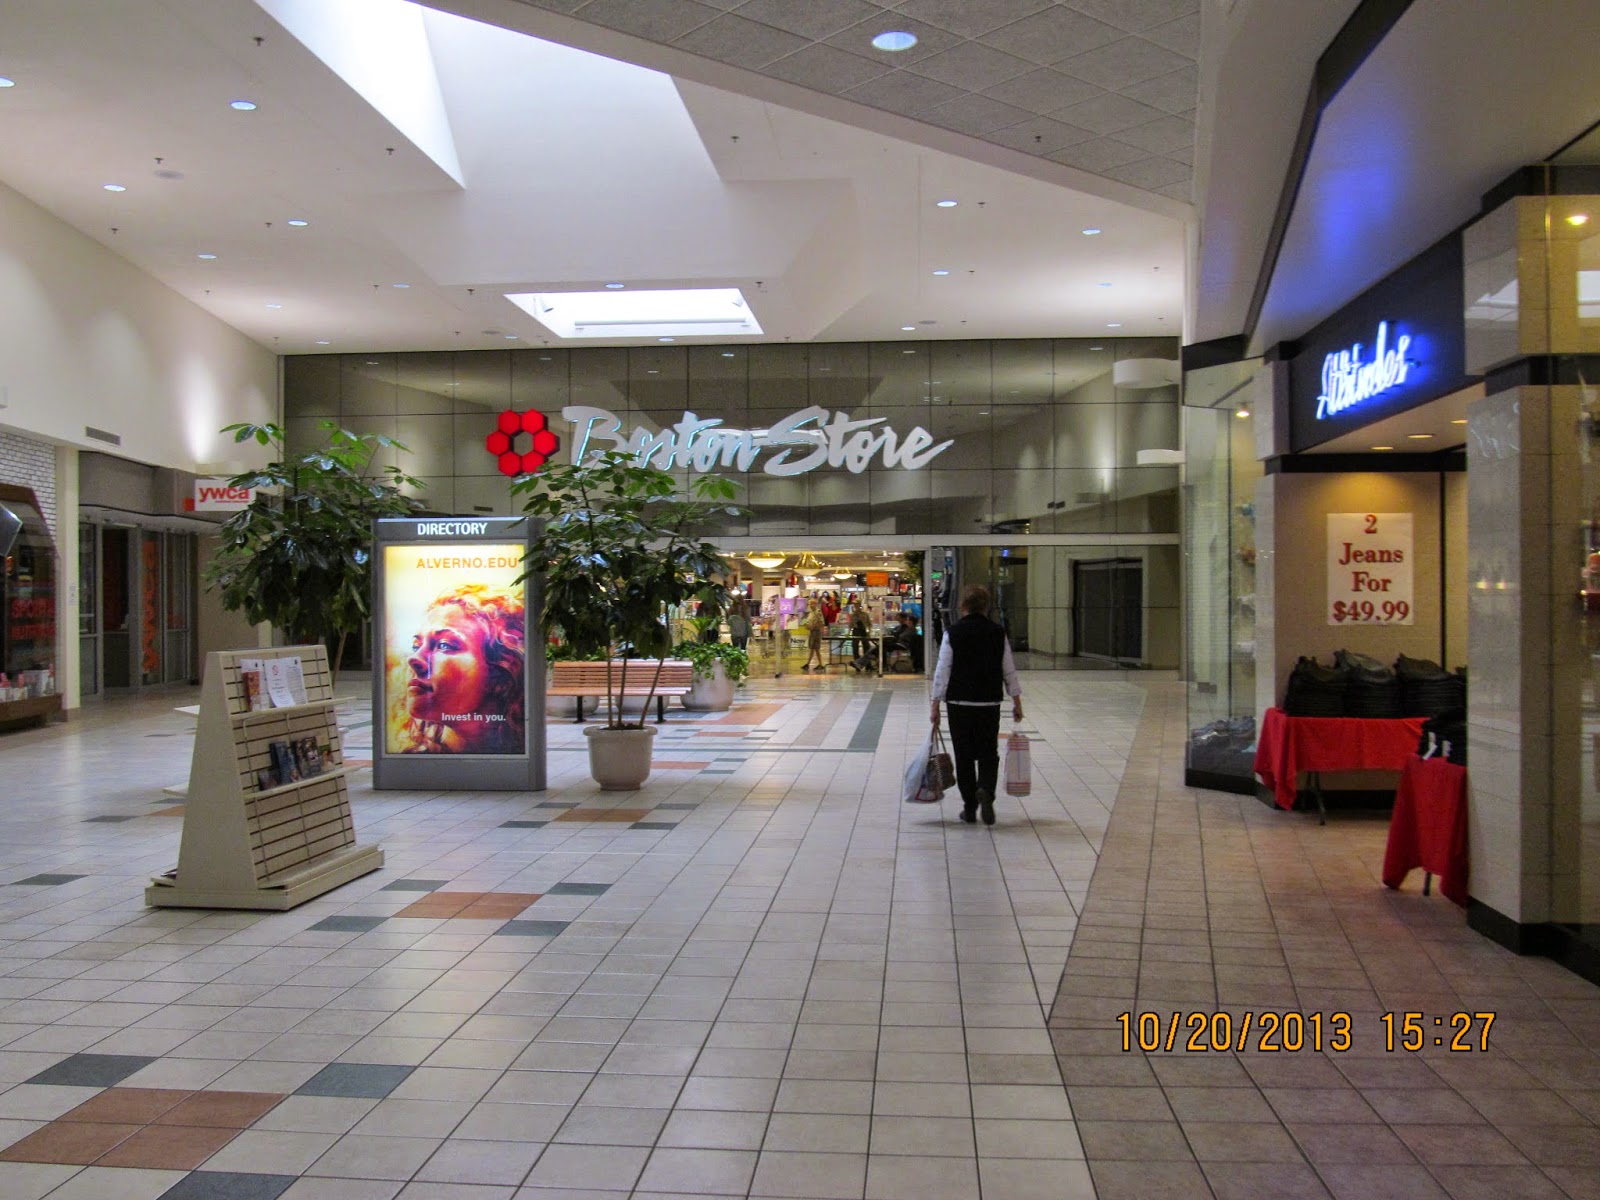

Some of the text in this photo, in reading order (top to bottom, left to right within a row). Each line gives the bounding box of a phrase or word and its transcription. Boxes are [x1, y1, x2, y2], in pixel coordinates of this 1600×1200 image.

[561, 404, 955, 476] Boston Store
[199, 487, 250, 503] ywca
[417, 522, 488, 535] DIRECTORY
[1364, 514, 1378, 534] 2
[416, 557, 519, 569] ALVERNO.EDU
[1338, 542, 1404, 564] Jeans
[1351, 571, 1392, 593] For
[1333, 600, 1409, 623] $49.99
[441, 712, 507, 725] Invest in you.
